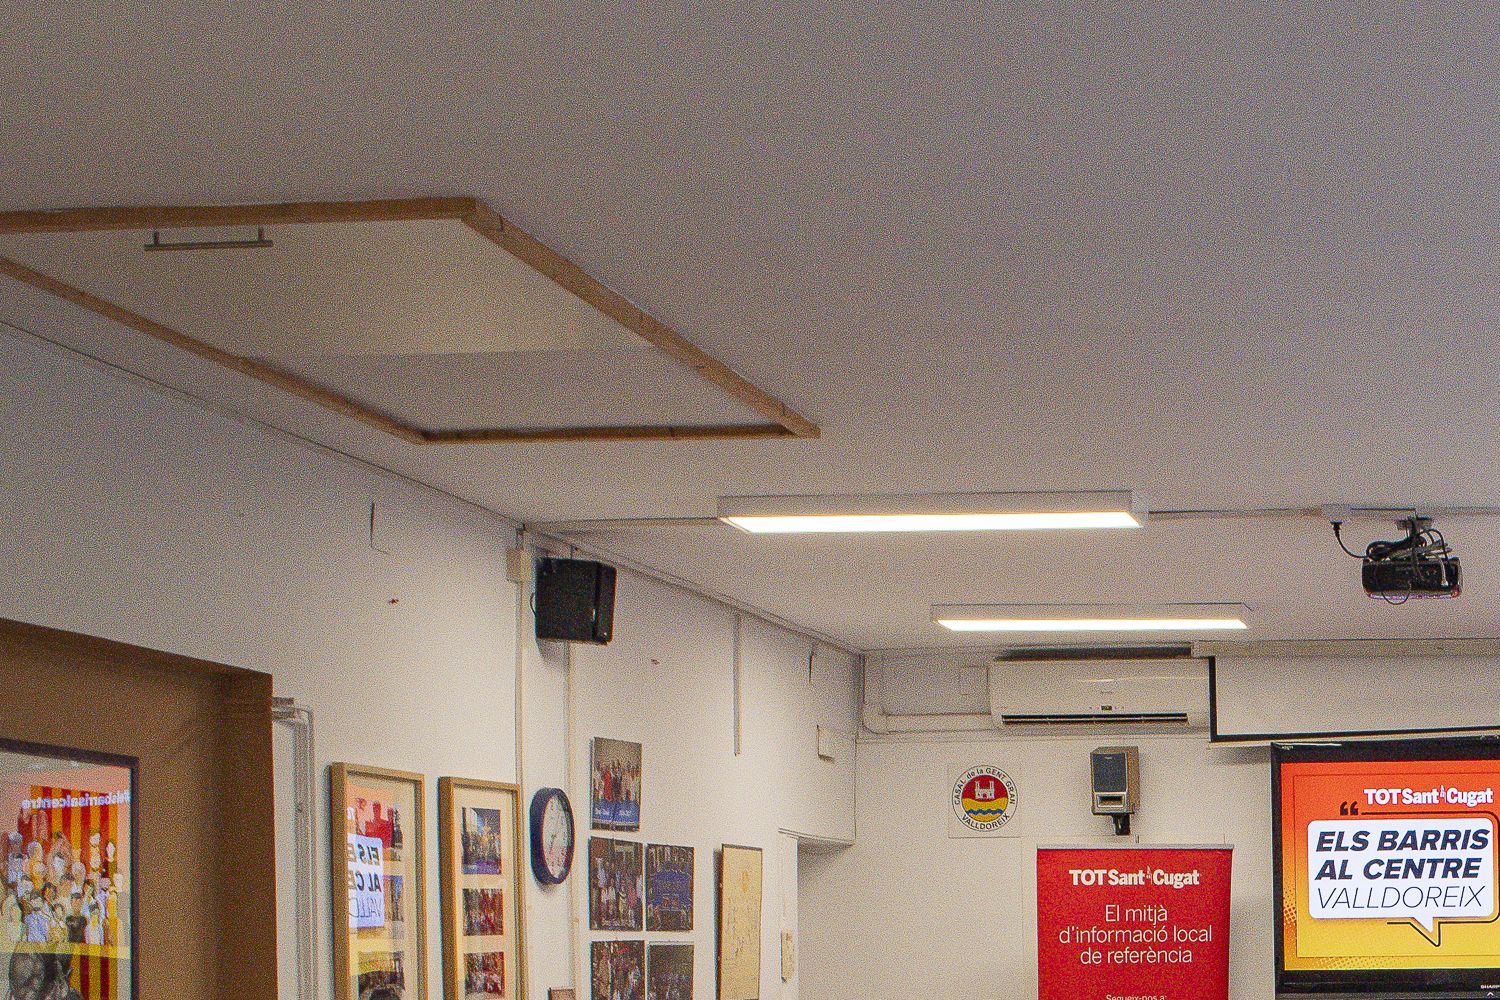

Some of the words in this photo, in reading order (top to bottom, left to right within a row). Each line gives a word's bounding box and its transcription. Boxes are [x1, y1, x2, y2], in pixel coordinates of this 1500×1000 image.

[954, 779, 966, 805] CASAL
[985, 767, 1008, 781] GENT
[1005, 780, 1017, 805] GRAN
[1446, 787, 1494, 808] Cugat
[961, 812, 1010, 830] VALLDOREIX
[1315, 830, 1371, 853] ELS
[1377, 829, 1490, 852] BARRIS
[1152, 868, 1200, 889] Cugat
[1314, 859, 1353, 881] AL
[1363, 857, 1482, 881] CENTRE
[1317, 884, 1486, 910] VALLDOREIX
[1105, 904, 1120, 922] El
[1125, 904, 1168, 926] mitjà
[1058, 925, 1168, 944] d'informació
[1173, 925, 1212, 943] local
[1080, 947, 1102, 965] de
[1107, 946, 1192, 964] referència
